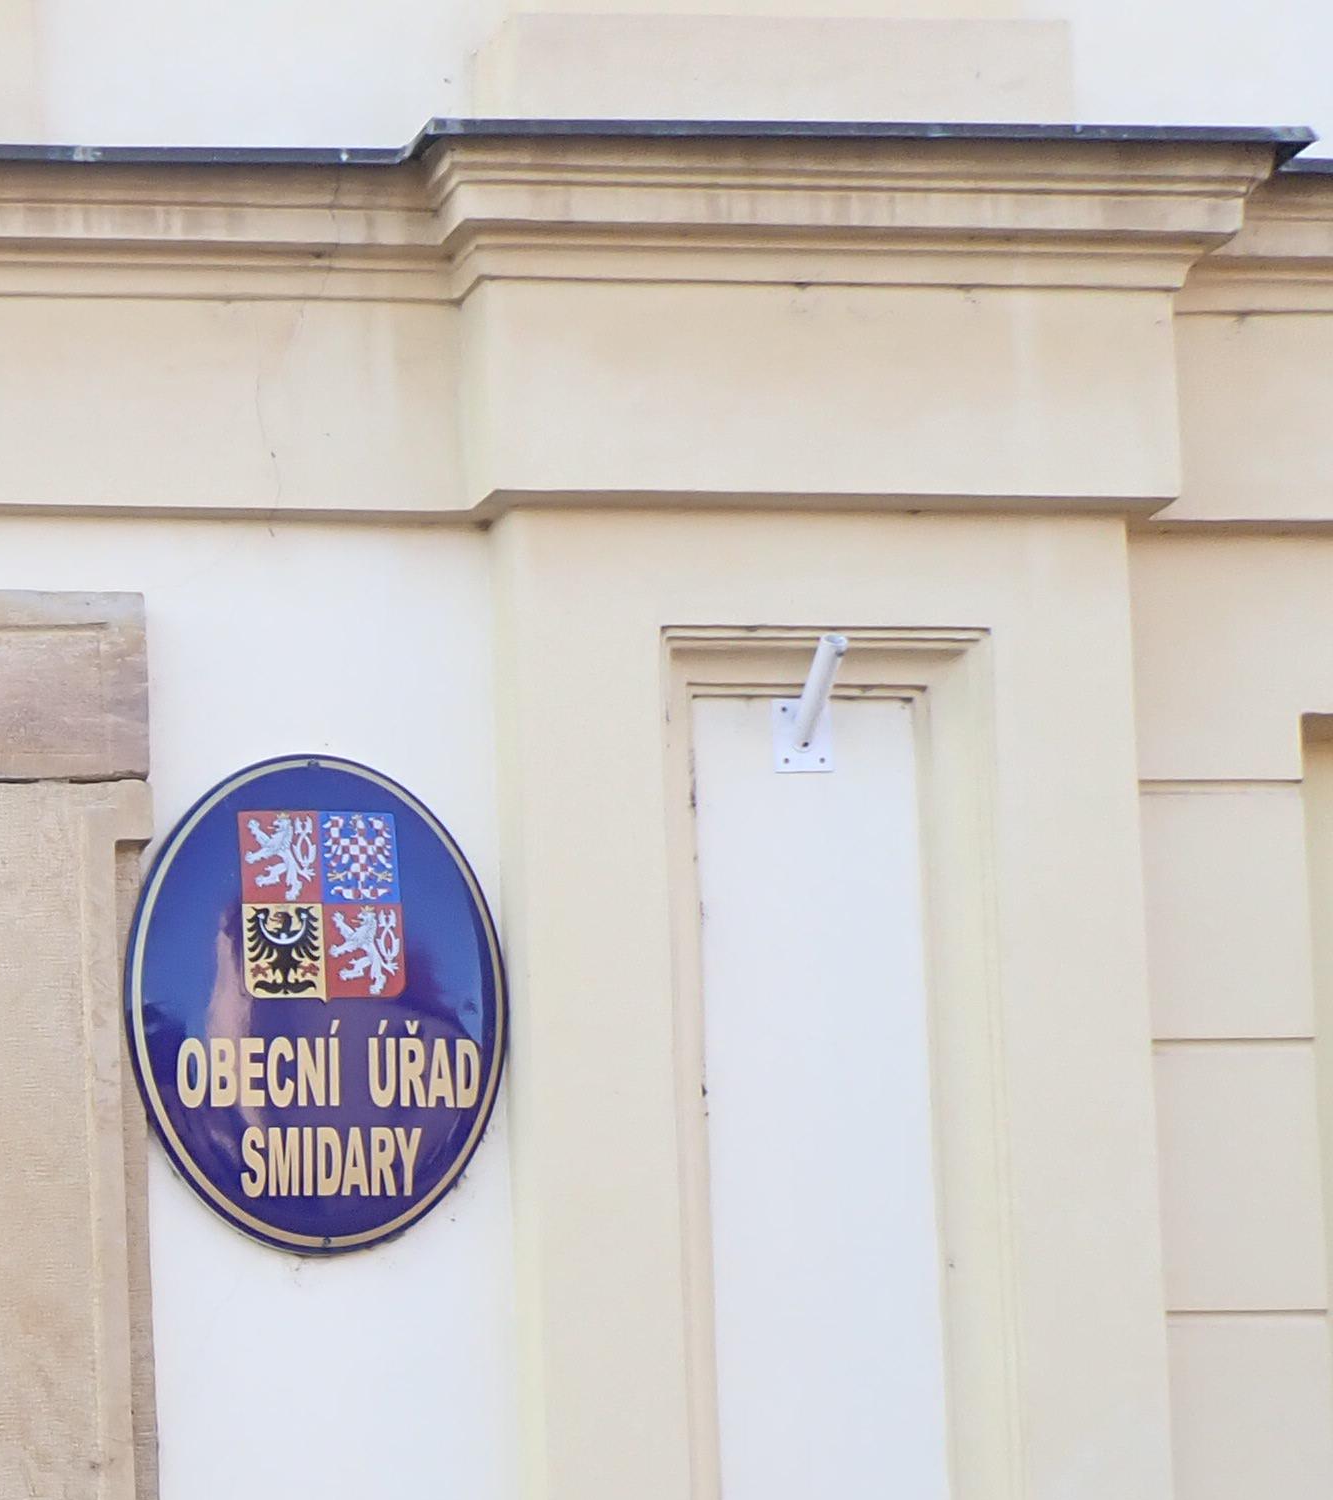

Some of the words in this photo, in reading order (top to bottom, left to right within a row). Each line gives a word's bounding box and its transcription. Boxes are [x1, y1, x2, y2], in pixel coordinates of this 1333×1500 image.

[176, 1020, 341, 1108] OBECNÍ
[367, 1020, 481, 1108] ÚŘAD
[240, 1126, 422, 1197] SMIDARY
